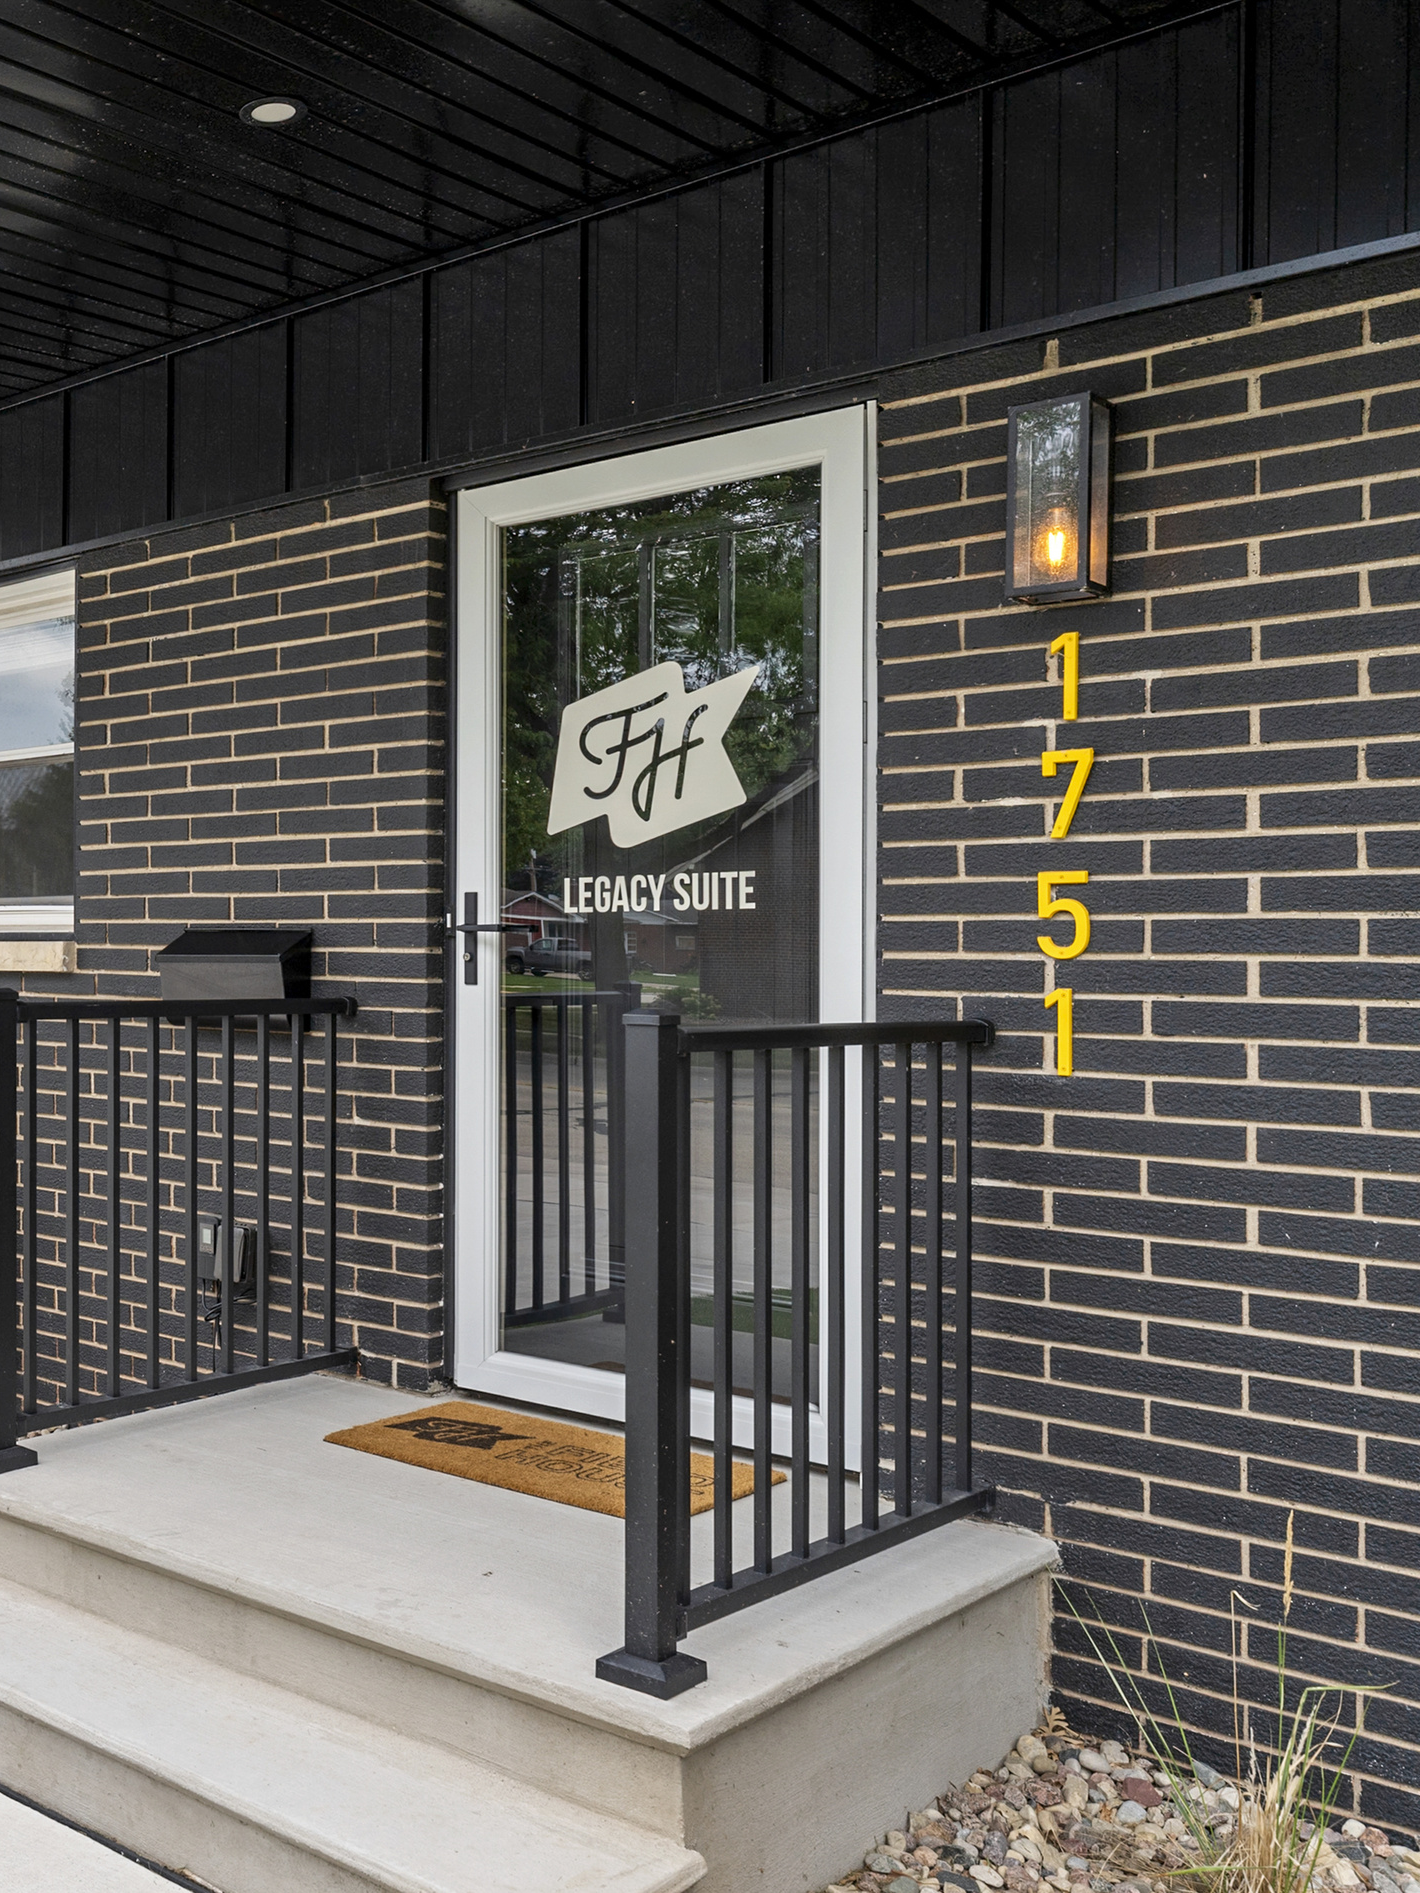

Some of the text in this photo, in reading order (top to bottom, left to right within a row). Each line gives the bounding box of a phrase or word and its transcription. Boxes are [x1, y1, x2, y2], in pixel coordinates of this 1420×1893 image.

[563, 870, 756, 914] LEGACY SUITE
[1036, 631, 1095, 1077] 1751
